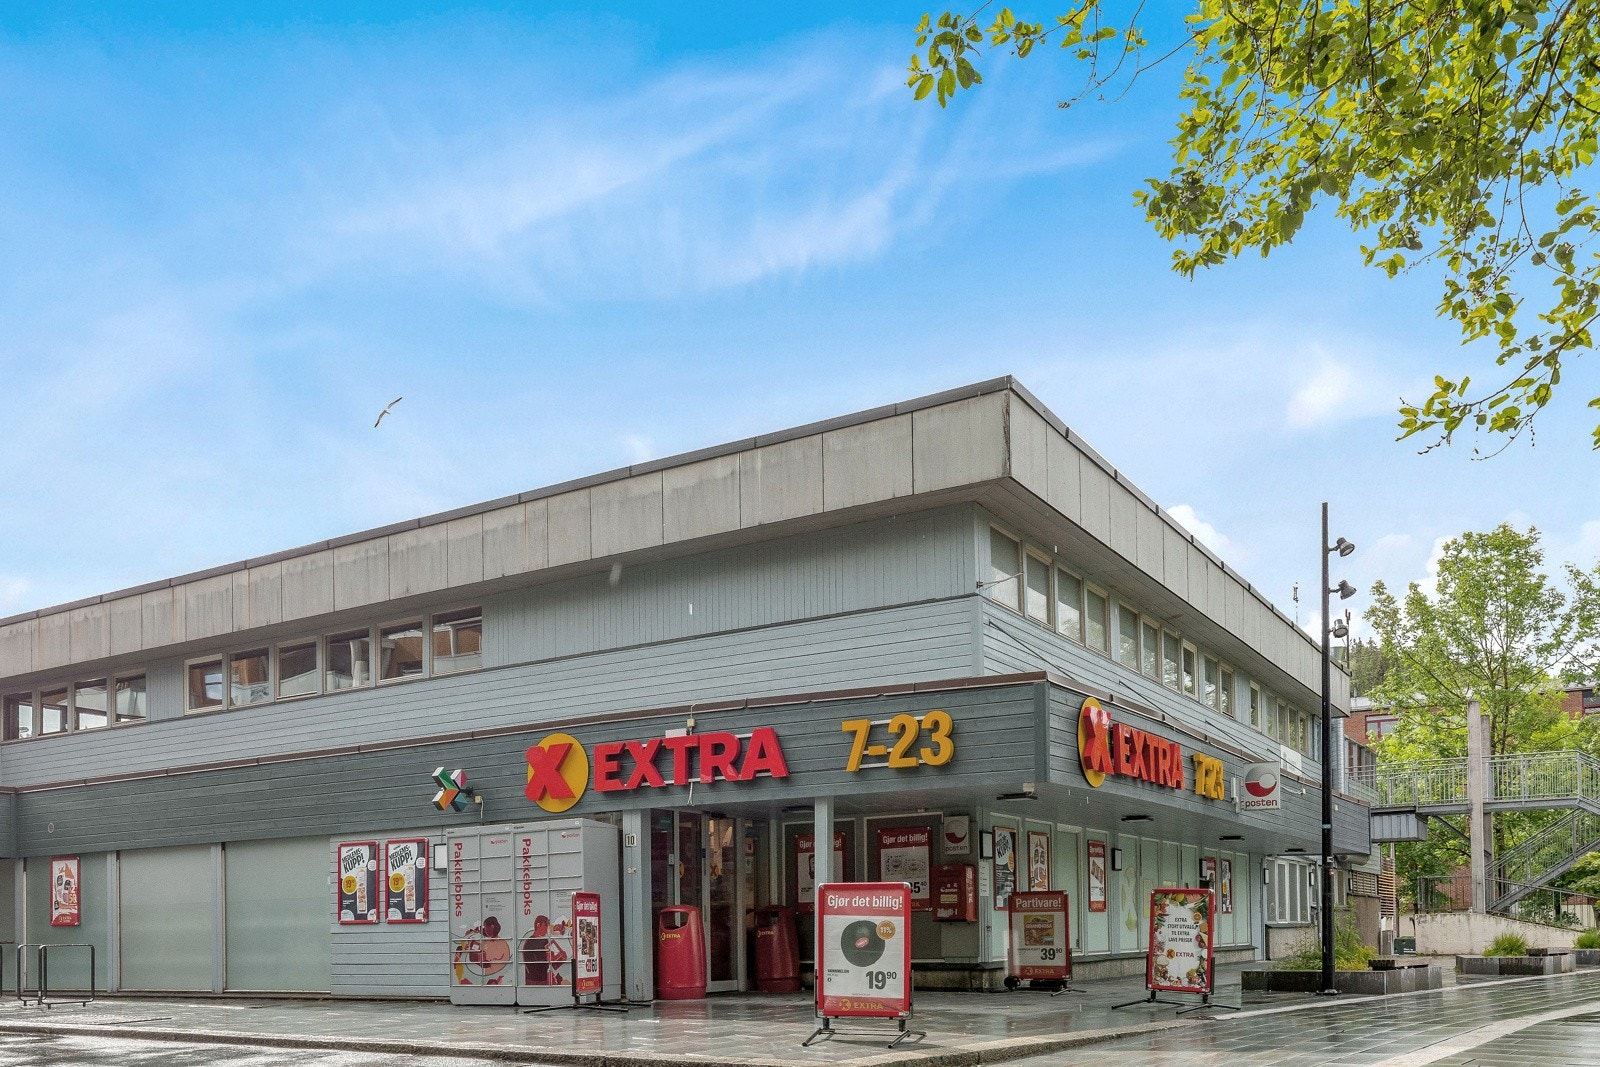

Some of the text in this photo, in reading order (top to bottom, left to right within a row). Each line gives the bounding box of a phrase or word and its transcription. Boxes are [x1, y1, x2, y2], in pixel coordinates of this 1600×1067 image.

[841, 710, 954, 773] 7-23
[594, 726, 790, 792] EXTRA
[1113, 723, 1186, 790] EXTRA
[1245, 799, 1278, 809] posten
[627, 835, 635, 846] 10
[883, 832, 928, 844] Gjør det billig!
[945, 845, 968, 853] posten
[343, 853, 365, 874] KUPP!
[390, 850, 413, 871] KUPP!
[454, 842, 464, 917] Pakkeboks
[522, 838, 533, 916] Pakkeboks
[827, 895, 903, 911] Gjør det billig!
[1016, 898, 1062, 908] Partivare!
[853, 1002, 884, 1010] EXTRA
